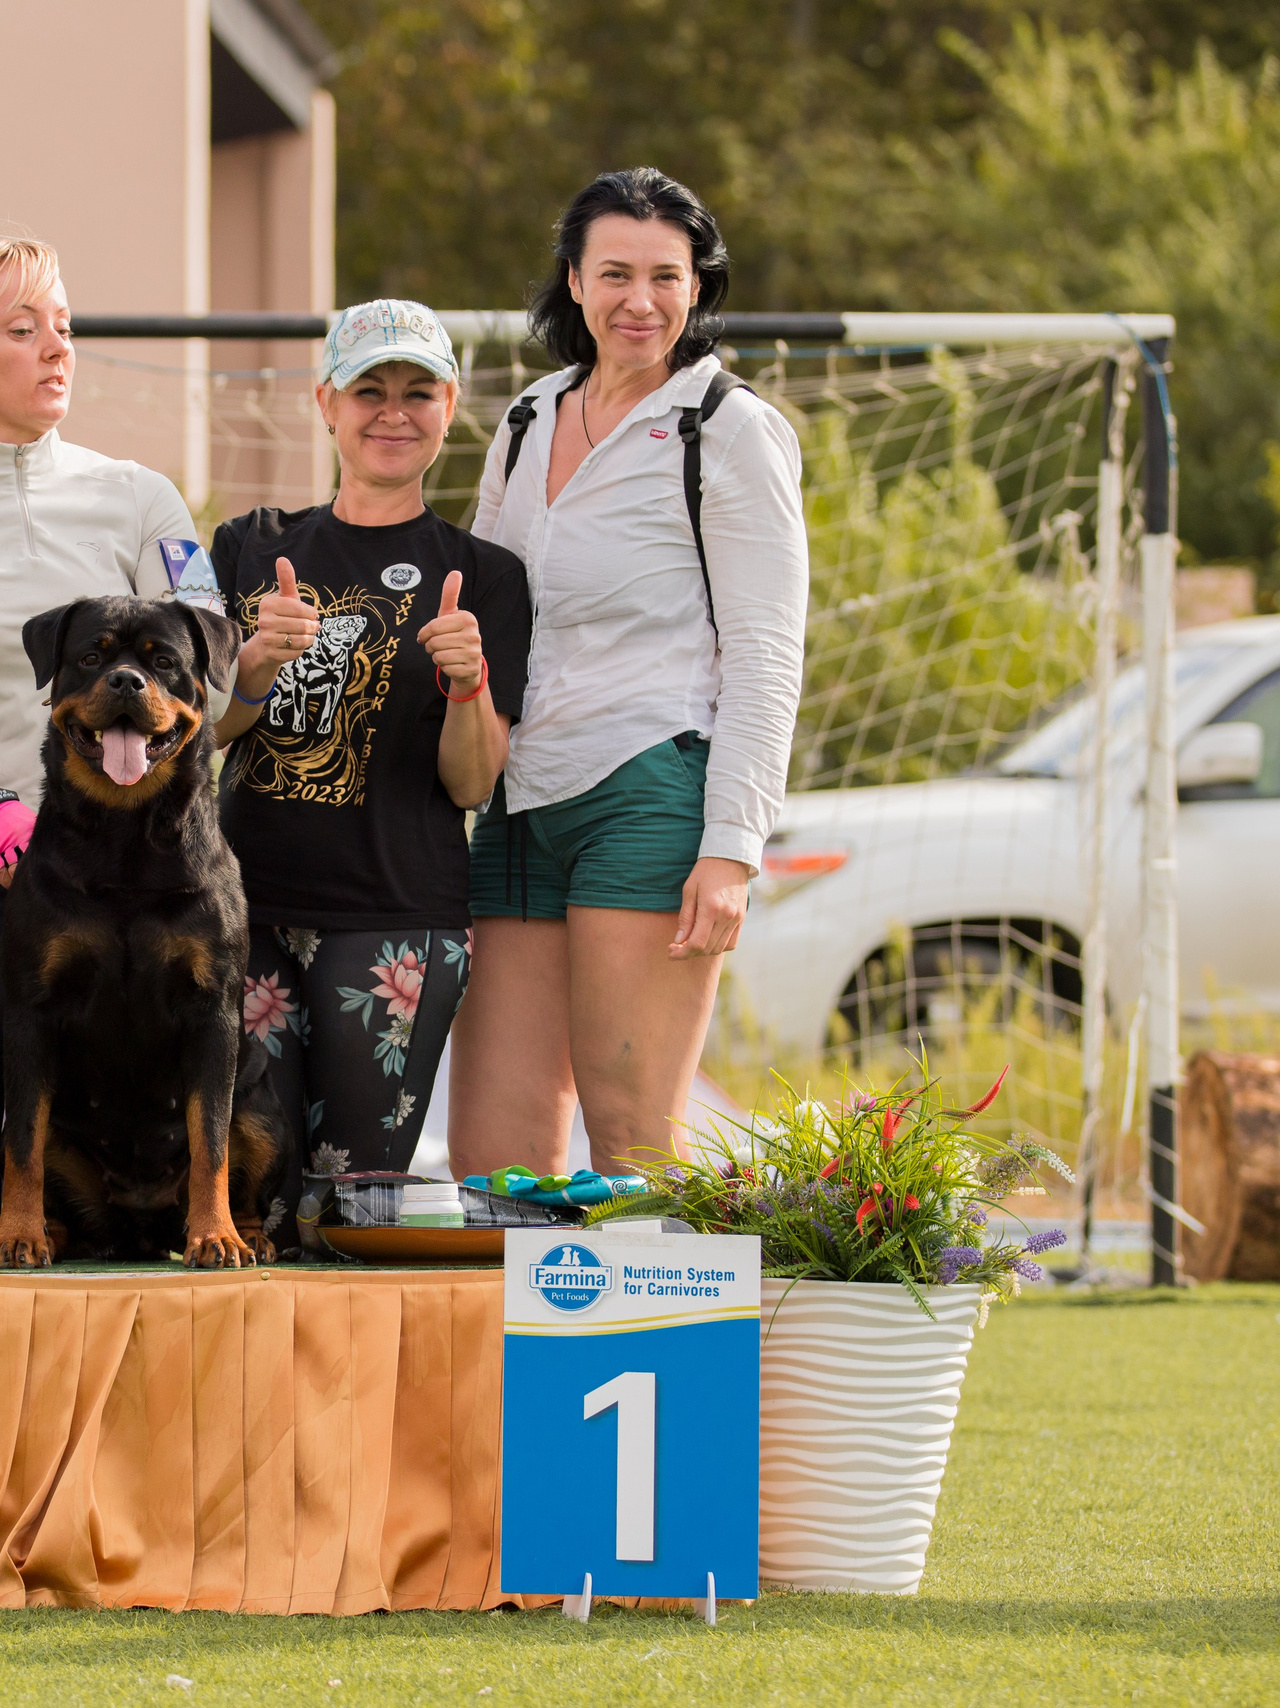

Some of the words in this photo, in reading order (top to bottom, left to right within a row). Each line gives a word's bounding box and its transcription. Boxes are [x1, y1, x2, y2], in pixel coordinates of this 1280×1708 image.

[340, 309, 436, 346] CHICAGO
[372, 636, 401, 711] КУБОК
[353, 727, 377, 806] ТВЕРИ
[286, 781, 346, 804] 2023
[535, 1267, 606, 1287] Farmina
[623, 1265, 682, 1280] Nutrition
[687, 1267, 735, 1284] System
[551, 1291, 564, 1301] Pet
[566, 1292, 590, 1302] Foods
[624, 1281, 642, 1295] for
[647, 1282, 720, 1297] Carnivores
[584, 1371, 656, 1561] 1
